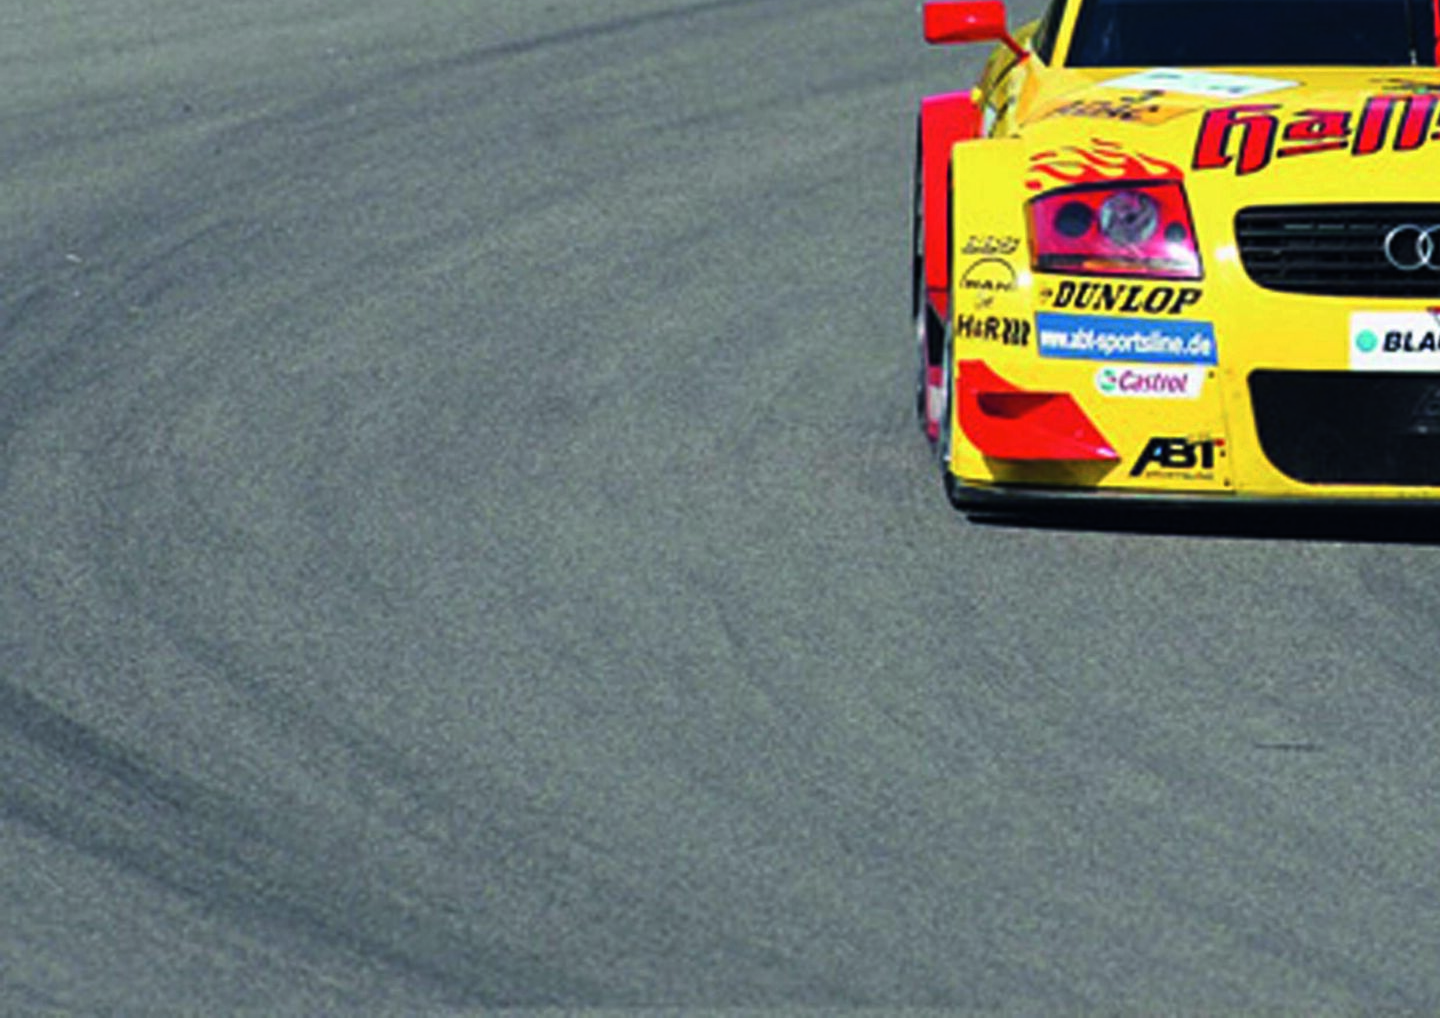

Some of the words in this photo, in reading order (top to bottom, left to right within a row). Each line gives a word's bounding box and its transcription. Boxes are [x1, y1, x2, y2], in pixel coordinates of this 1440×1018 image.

[1052, 280, 1202, 314] DUNLOP
[1118, 370, 1190, 393] Castrol
[1129, 436, 1226, 477] ABT
